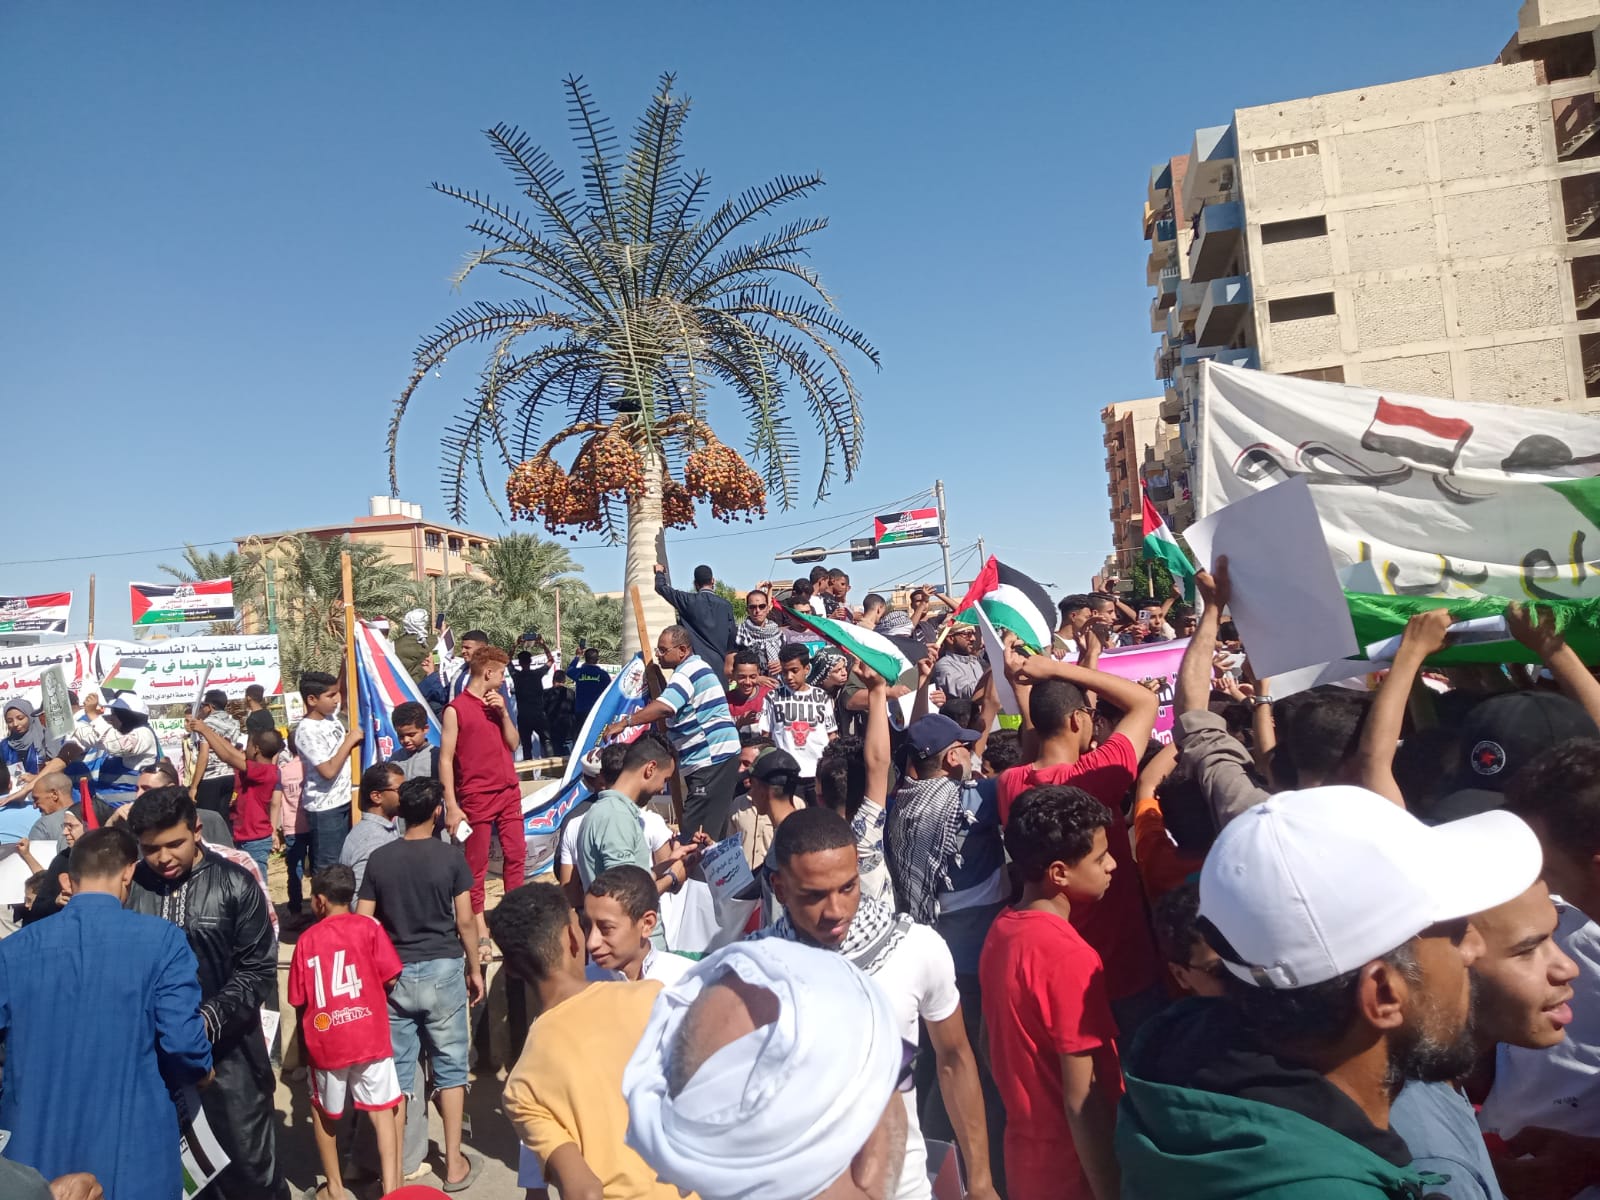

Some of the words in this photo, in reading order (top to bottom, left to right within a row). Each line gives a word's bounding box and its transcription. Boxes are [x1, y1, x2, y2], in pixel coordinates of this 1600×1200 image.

[115, 645, 190, 658] الفلسطينية
[192, 643, 242, 655] للقضية
[245, 642, 278, 651] دعمنا
[27, 652, 74, 667] دعمنا
[162, 659, 176, 676] في
[150, 673, 199, 688] أمانة
[578, 672, 601, 683] إسعاف
[773, 702, 826, 724] BULLS
[307, 950, 363, 1009] 14
[333, 1008, 370, 1025] HELIX
